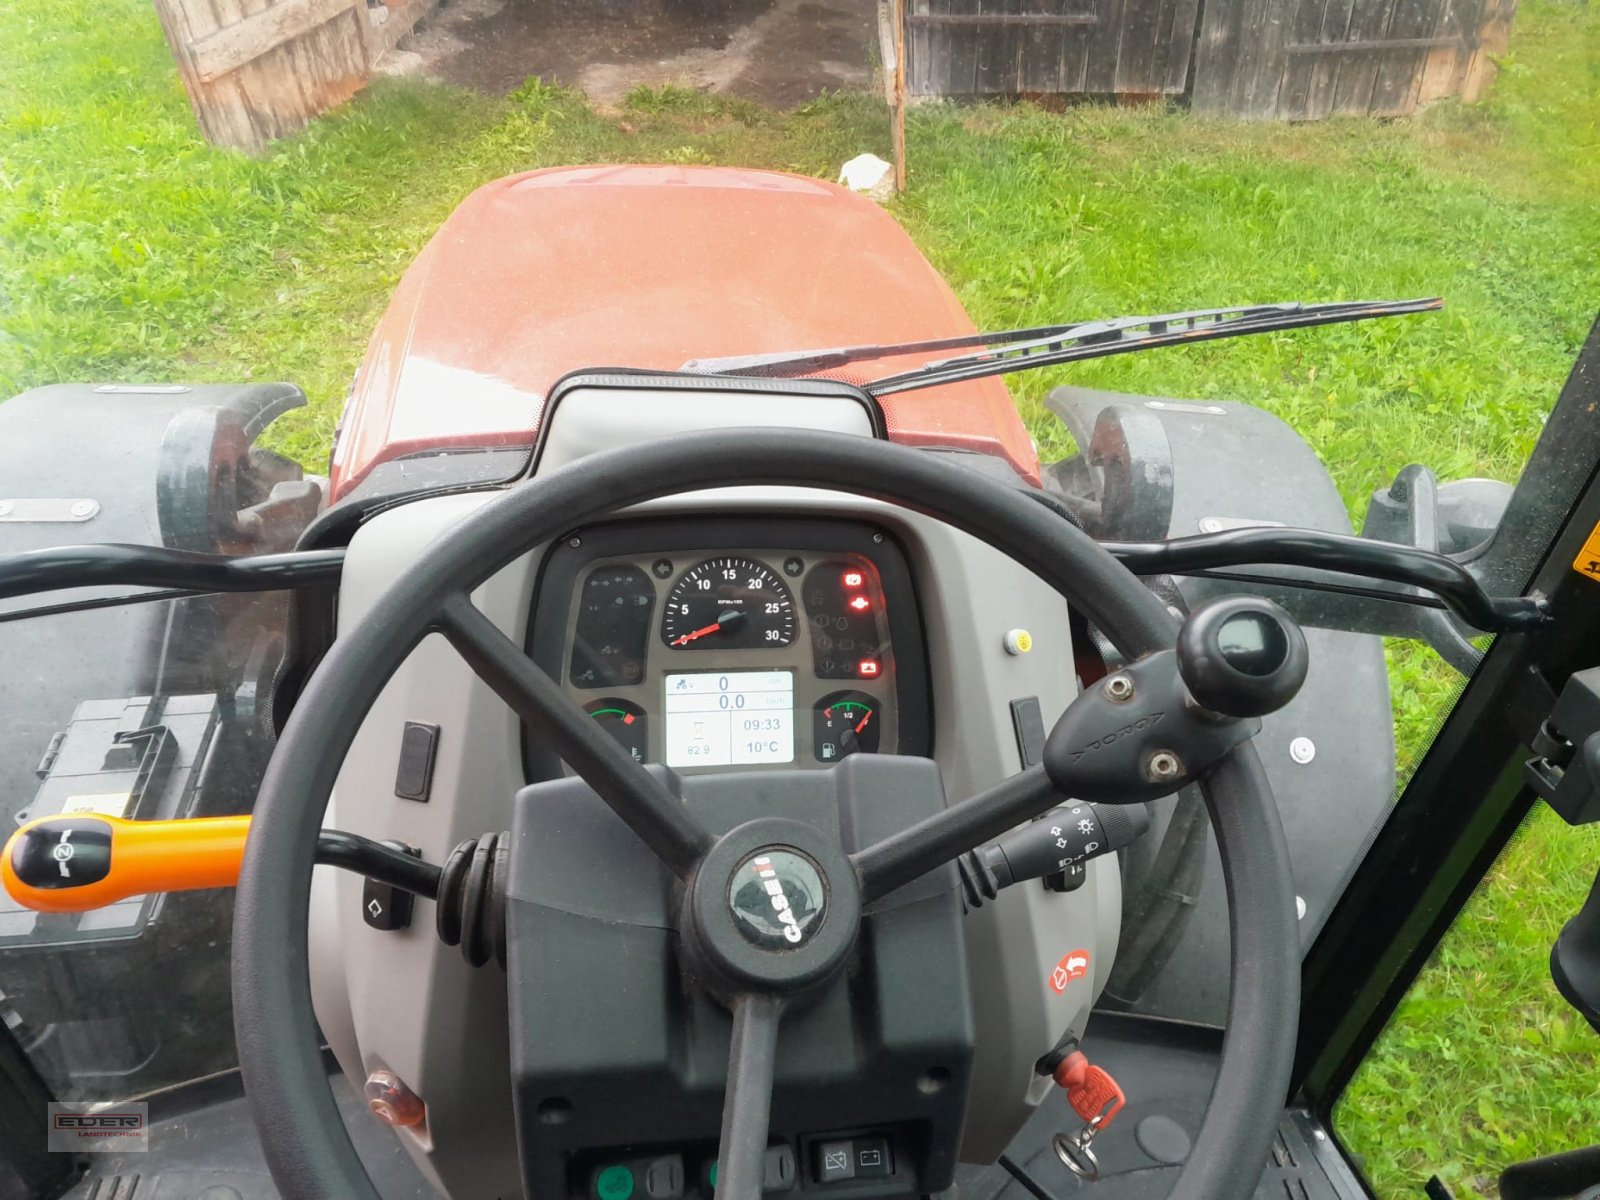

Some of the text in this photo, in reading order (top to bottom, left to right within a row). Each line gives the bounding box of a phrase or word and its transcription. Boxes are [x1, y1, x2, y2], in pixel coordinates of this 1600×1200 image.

[722, 570, 737, 580] 15
[697, 579, 711, 590] 10
[748, 578, 763, 589] 20
[681, 604, 689, 615] 5
[765, 602, 780, 614] 25
[765, 630, 780, 641] 30
[719, 676, 729, 691] 0
[719, 694, 745, 709] 0.0
[744, 718, 781, 731] 09:33
[747, 741, 779, 753] 10°C
